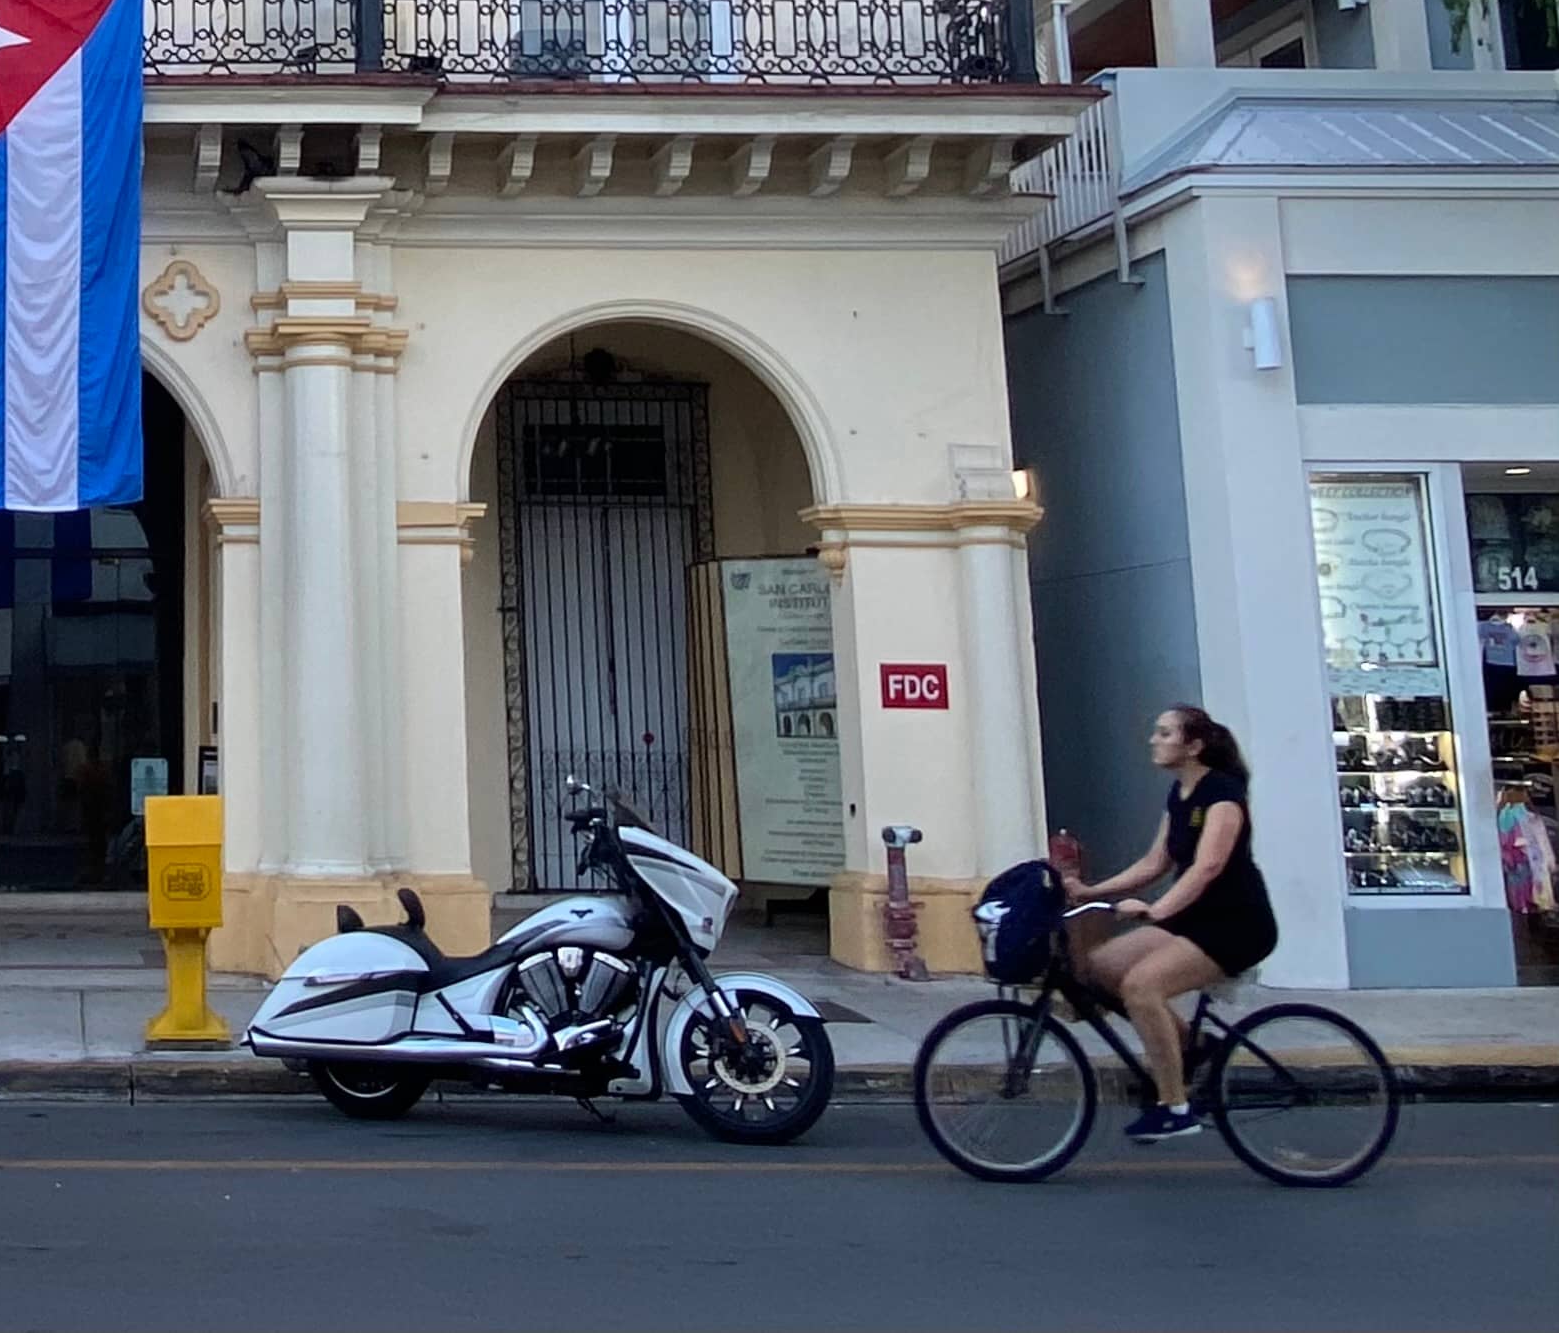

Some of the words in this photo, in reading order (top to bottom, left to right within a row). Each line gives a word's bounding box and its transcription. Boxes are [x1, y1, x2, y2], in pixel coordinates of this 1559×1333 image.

[758, 582, 786, 595] SAN
[1498, 566, 1539, 590] 514
[889, 674, 940, 700] FDC
